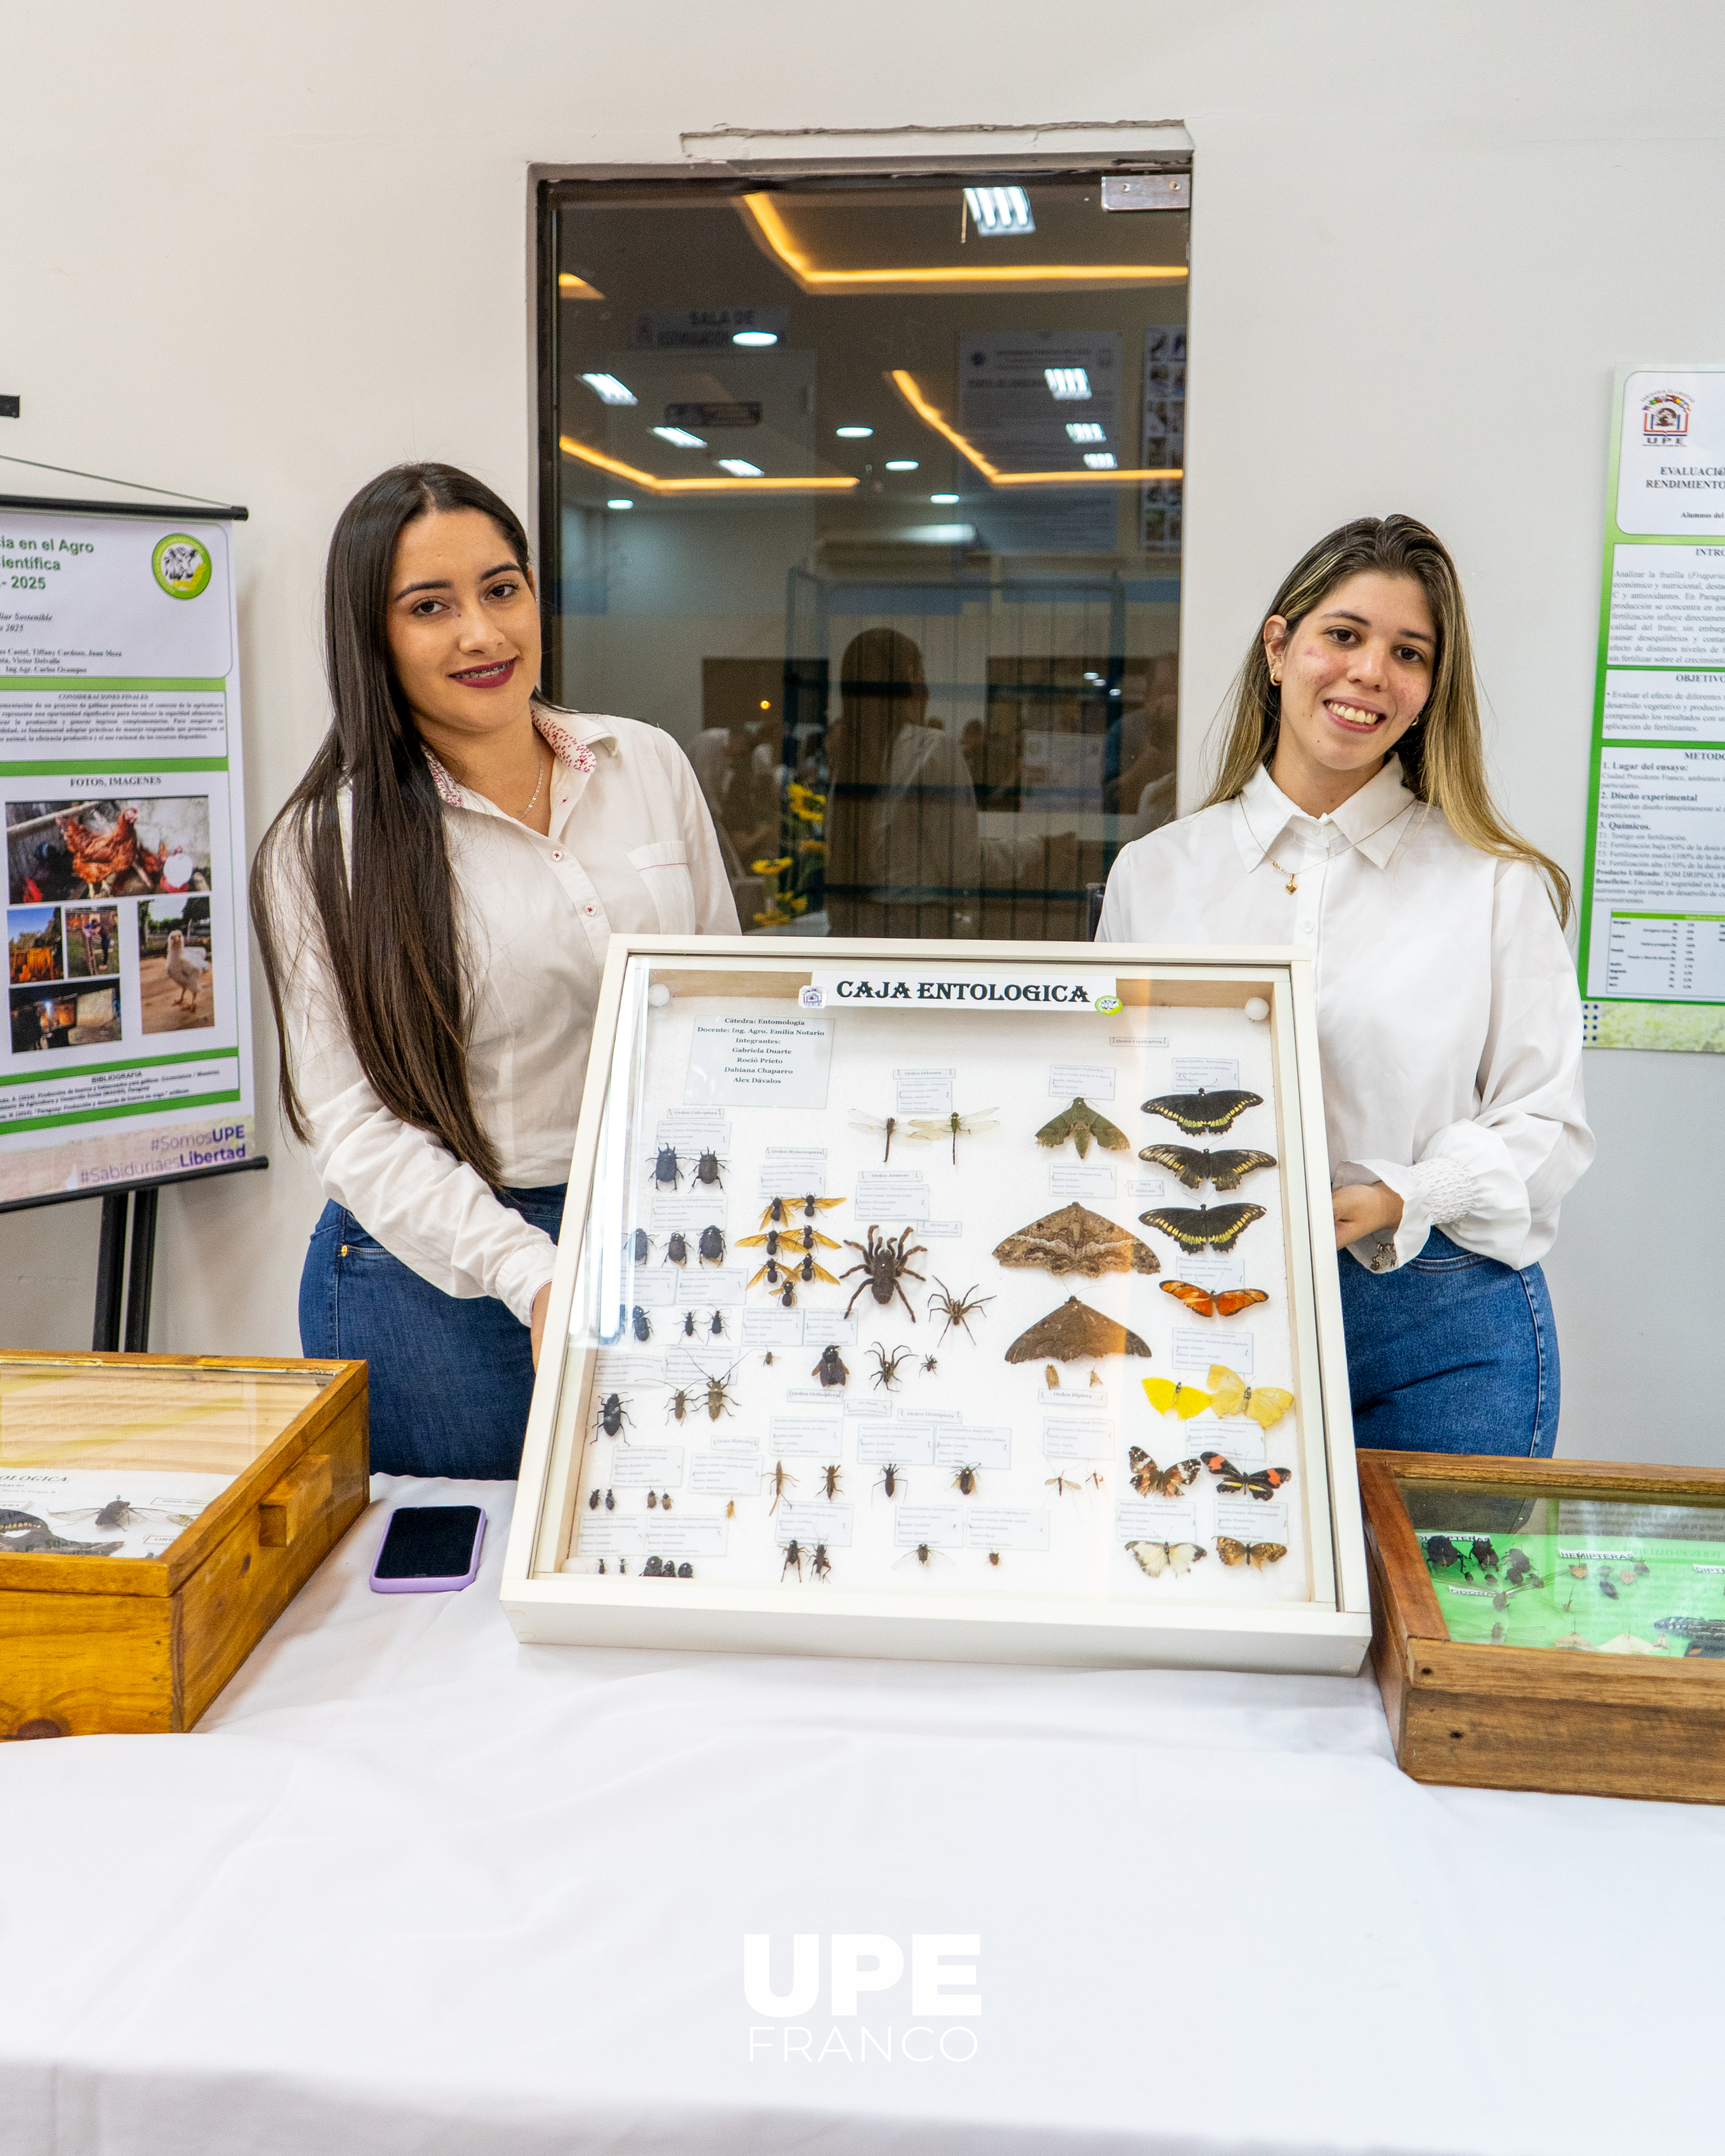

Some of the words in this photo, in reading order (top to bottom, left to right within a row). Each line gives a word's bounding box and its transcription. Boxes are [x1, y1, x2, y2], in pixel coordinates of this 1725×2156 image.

[0, 535, 14, 549] ia
[19, 539, 37, 550] en
[41, 538, 55, 551] el
[59, 538, 94, 556] Agro
[0, 555, 61, 571] ientífica
[11, 575, 46, 590] 2025
[14, 611, 53, 622] Sostenible
[5, 623, 24, 633] 2025
[1654, 655, 1674, 663] sobre
[1674, 692, 1684, 700] de
[1613, 762, 1639, 772] Lugar
[1641, 763, 1655, 771] del
[70, 778, 107, 788] FOTOS,
[109, 776, 162, 786] IMAGENES
[1610, 791, 1639, 800] Diseño
[1641, 792, 1698, 803] experimental
[837, 980, 913, 999] CAJA
[917, 982, 1091, 1003] ENTOLOGICA
[758, 1018, 805, 1026] Entomología
[151, 1124, 245, 1152] #SomosUPE
[1561, 1551, 1635, 1559] HEMIPTERAS
